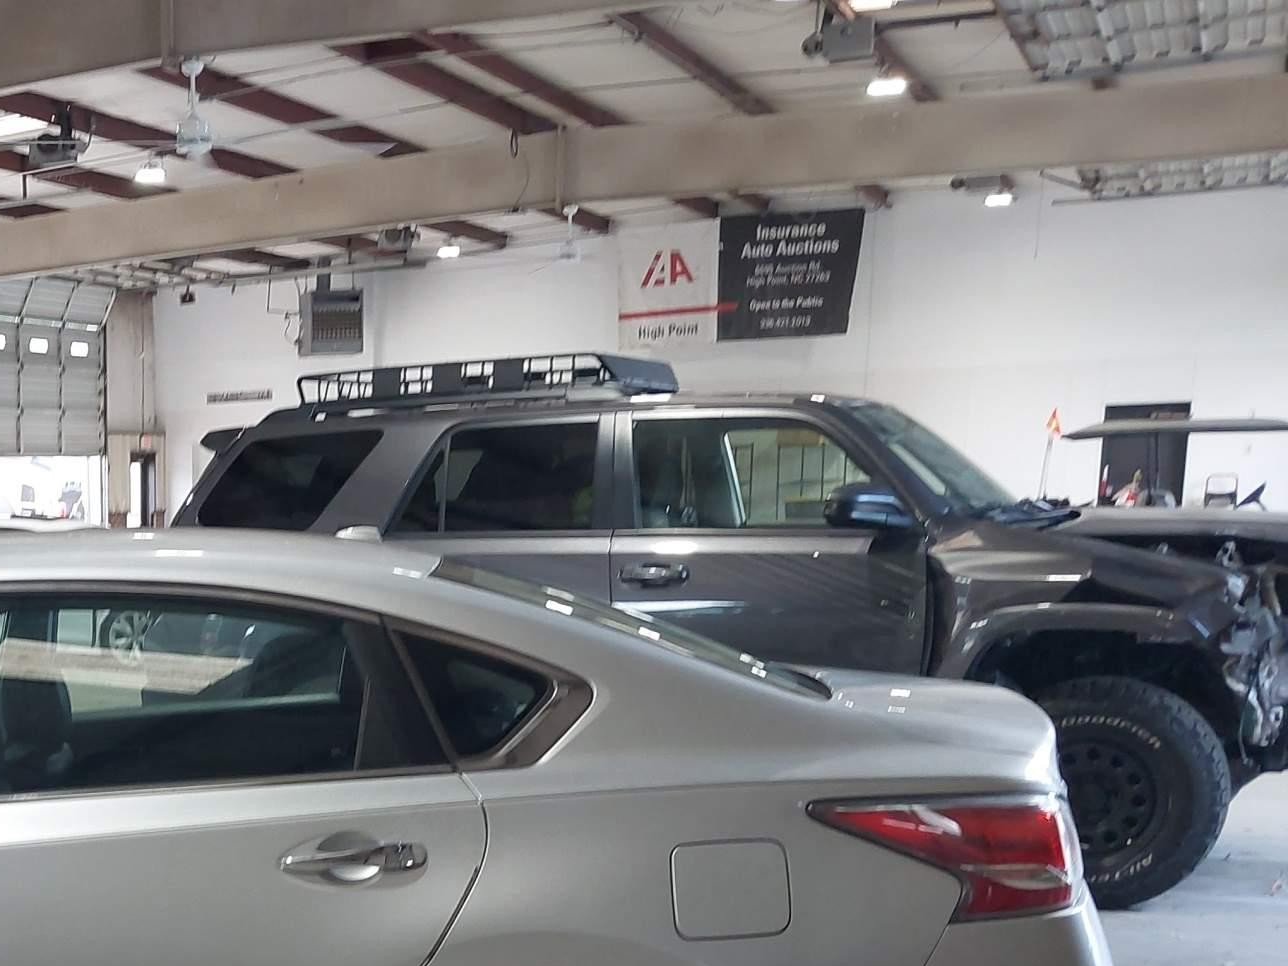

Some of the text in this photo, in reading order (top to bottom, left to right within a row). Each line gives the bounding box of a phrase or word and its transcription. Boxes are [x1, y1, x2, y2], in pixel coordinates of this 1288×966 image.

[756, 222, 827, 240] Insurance
[741, 238, 840, 259] Auto Auctions
[749, 296, 824, 312] Open to the Public
[638, 322, 699, 341] High Point
